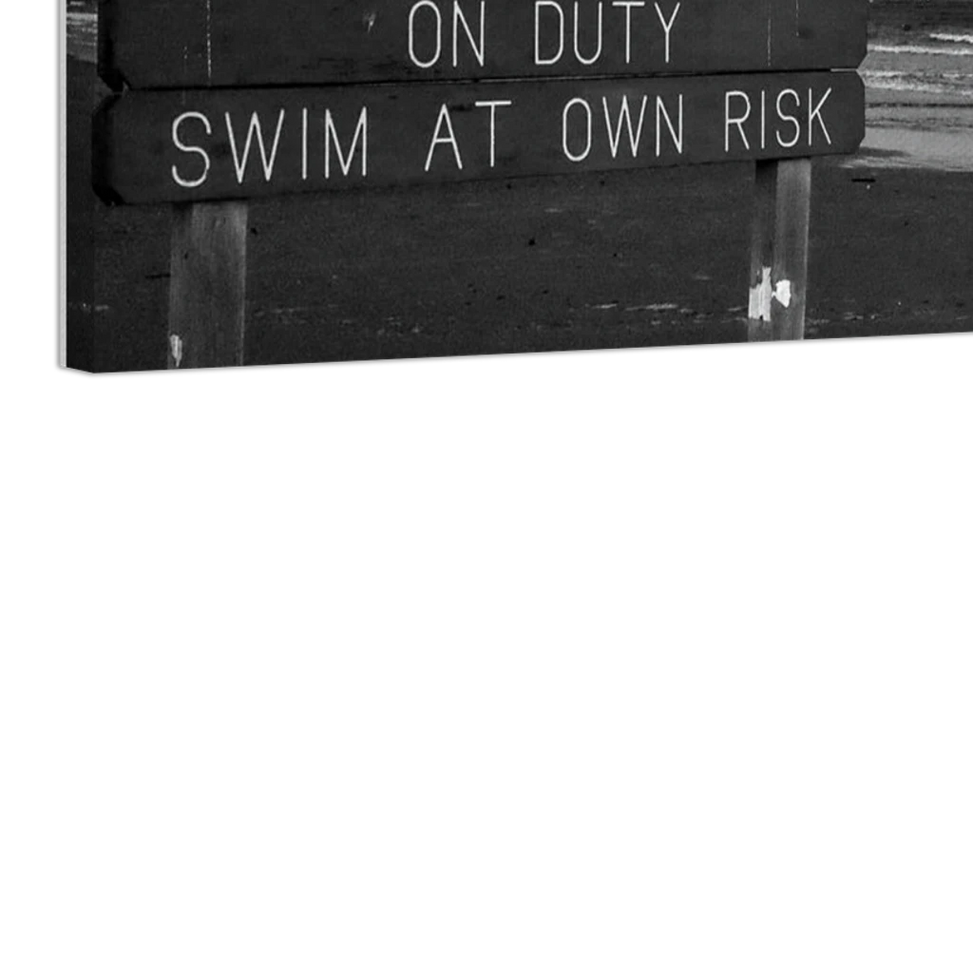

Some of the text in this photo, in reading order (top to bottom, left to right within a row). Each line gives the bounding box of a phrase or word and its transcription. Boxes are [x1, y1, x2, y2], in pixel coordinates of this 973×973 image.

[408, 0, 682, 68] ON DUTY
[171, 87, 832, 188] SWIM AT OWN RISK
